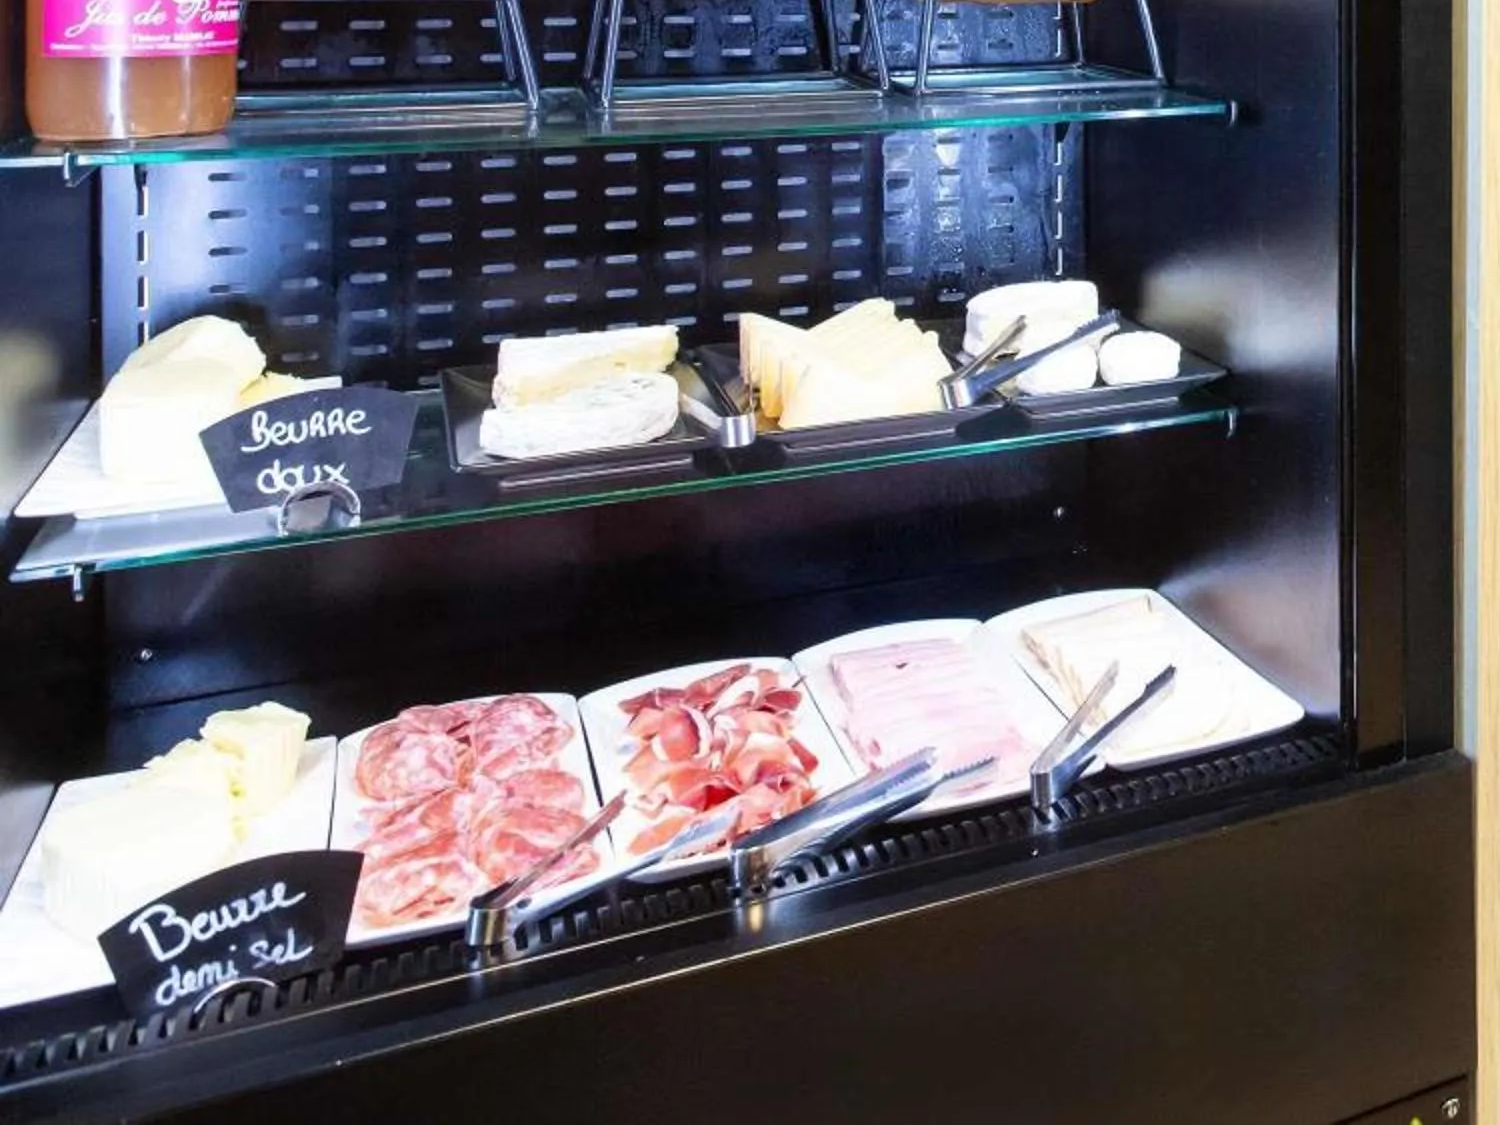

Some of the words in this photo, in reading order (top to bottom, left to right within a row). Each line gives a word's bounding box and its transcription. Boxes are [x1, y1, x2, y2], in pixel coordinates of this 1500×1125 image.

[132, 0, 167, 25] de
[176, 0, 240, 25] Pomm
[256, 459, 349, 494] doux
[128, 881, 307, 963] Beurre
[155, 945, 239, 1006] demi
